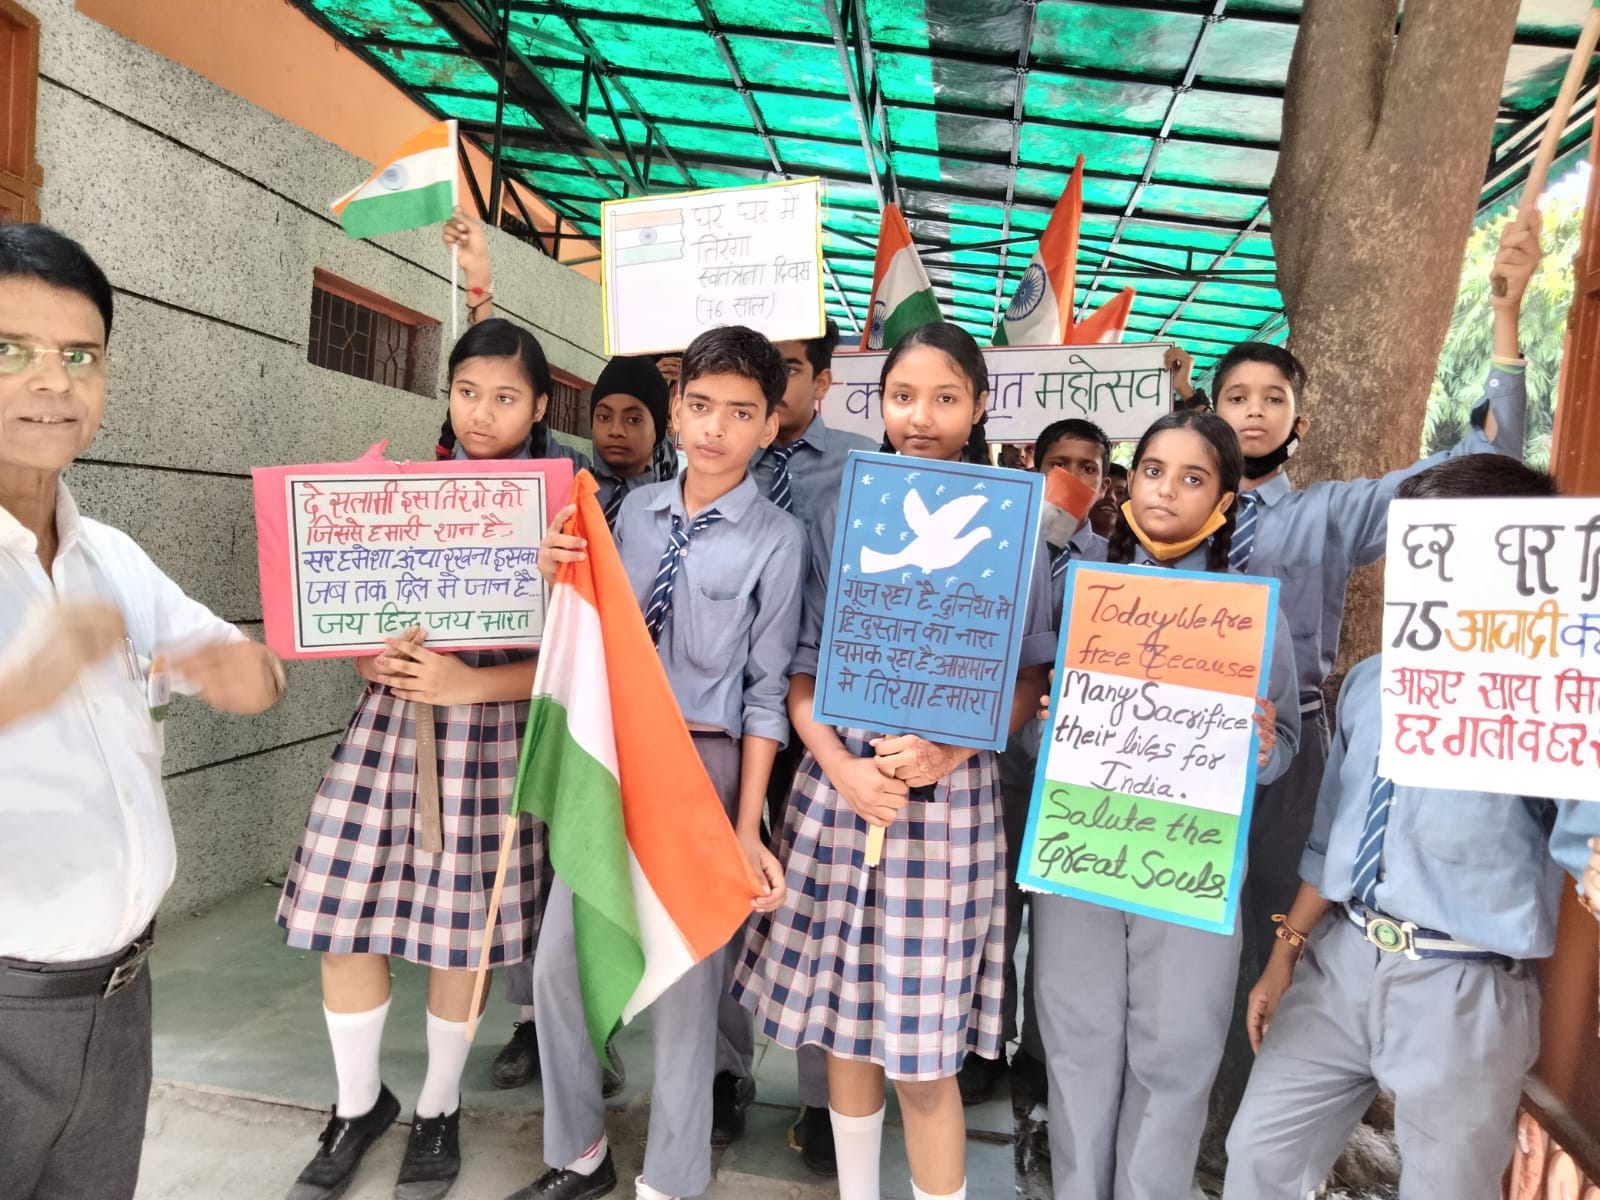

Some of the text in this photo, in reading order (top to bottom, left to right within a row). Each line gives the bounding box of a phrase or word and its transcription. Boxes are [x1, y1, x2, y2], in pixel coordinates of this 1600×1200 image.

[690, 233, 751, 265] तिरंगा
[774, 256, 813, 285] दिवस
[1035, 354, 1168, 416] महोत्सव
[329, 480, 398, 519] सलामी
[306, 514, 365, 546] जिससे
[367, 514, 432, 542] हमारी
[433, 522, 480, 542] शान
[305, 578, 350, 605] जब
[354, 579, 388, 603] तक
[395, 571, 432, 604] दिल
[464, 577, 511, 597] जान
[881, 584, 912, 611] रहा
[915, 580, 940, 611] है
[932, 582, 996, 620] दुनिया
[312, 611, 370, 634] जय
[424, 610, 476, 630] जय
[477, 609, 535, 632] भारत
[922, 622, 956, 645] का
[955, 628, 1000, 650] नारा
[1087, 584, 1253, 650] Today We Are
[1385, 600, 1449, 651] 75
[833, 639, 1003, 682] चमक रहा है आसमान
[1137, 642, 1256, 680] Because
[864, 668, 929, 709] तिरंगा
[1063, 670, 1249, 740] Many Sacrifice
[1055, 714, 1225, 772] their lives for
[1090, 760, 1188, 800] India.
[1045, 788, 1223, 845] Salute the
[1036, 831, 1128, 878] Great
